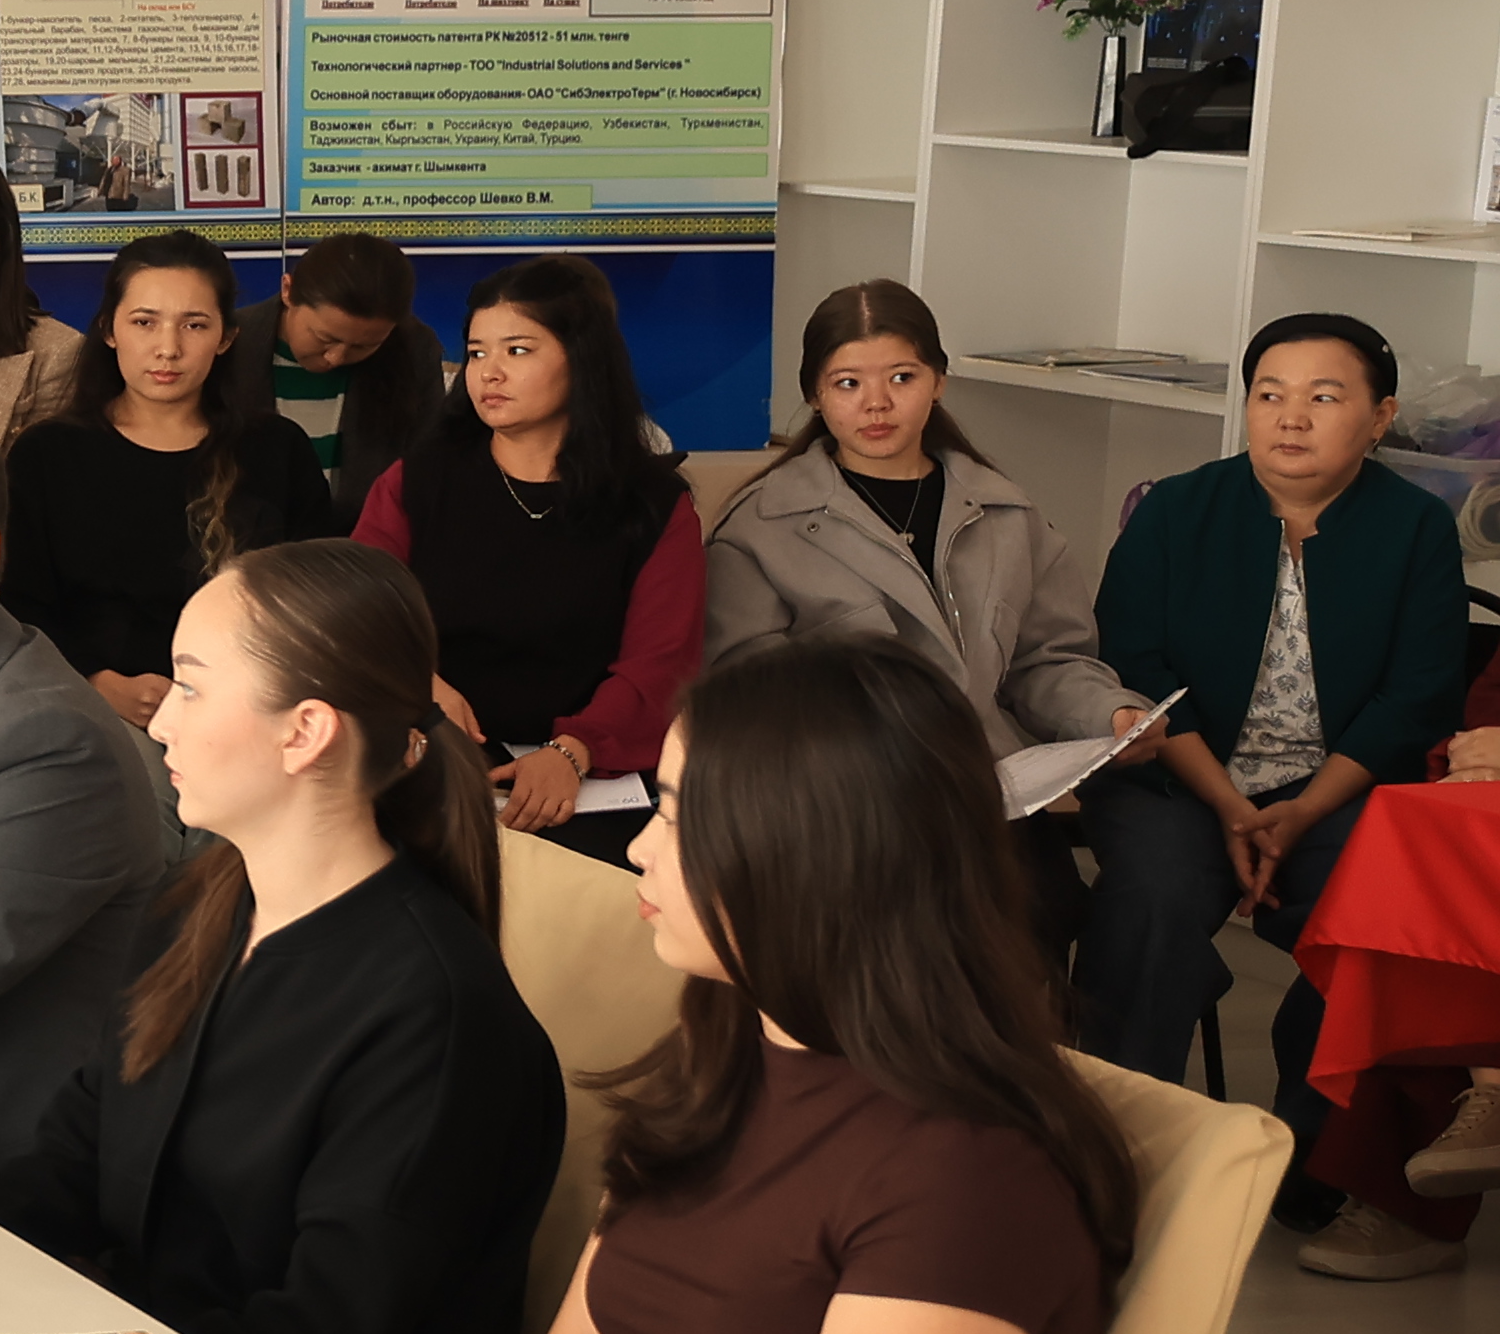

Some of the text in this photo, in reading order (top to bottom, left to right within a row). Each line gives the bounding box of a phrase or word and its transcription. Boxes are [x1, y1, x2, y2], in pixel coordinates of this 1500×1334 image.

[18, 193, 42, 203] Б.К.
[310, 191, 553, 207] Автор: д.т.н., профессор Шевко В.М.
